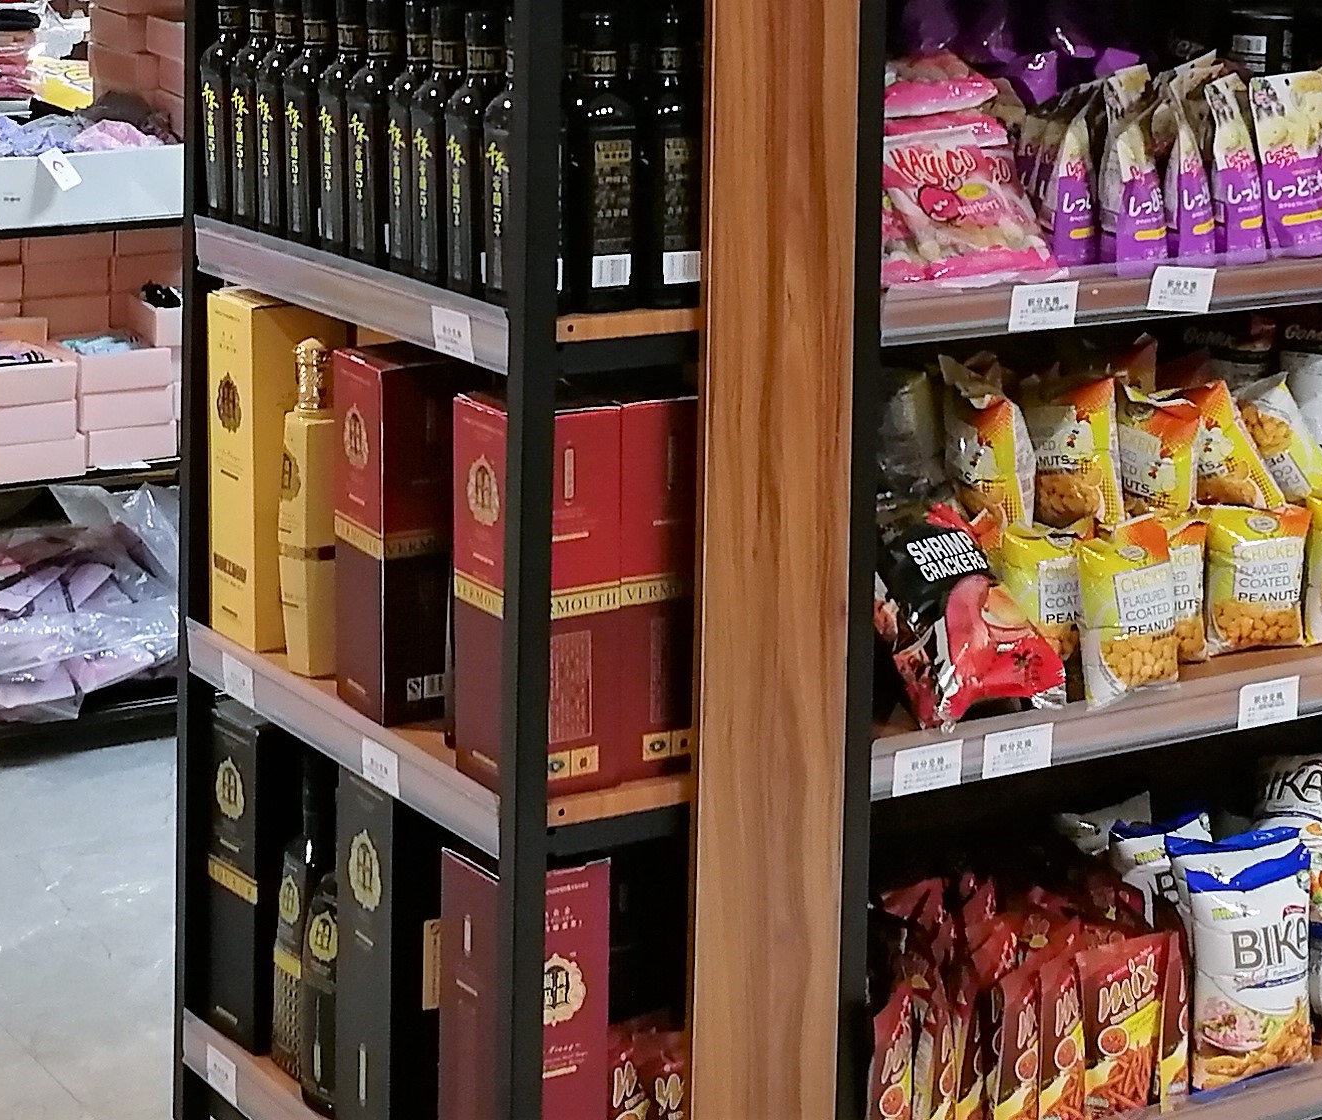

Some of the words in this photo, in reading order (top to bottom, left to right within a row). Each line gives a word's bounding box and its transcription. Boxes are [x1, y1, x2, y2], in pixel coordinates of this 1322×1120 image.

[907, 531, 974, 567] SHRIMP
[1239, 543, 1303, 562] CHICKEN
[920, 552, 988, 583] CRACKERS
[1239, 563, 1290, 577] FLAVOURED
[1238, 576, 1291, 590] COATED
[1238, 589, 1301, 603] PEANUTS
[1125, 604, 1170, 622] COATED
[1097, 952, 1160, 1024] mix
